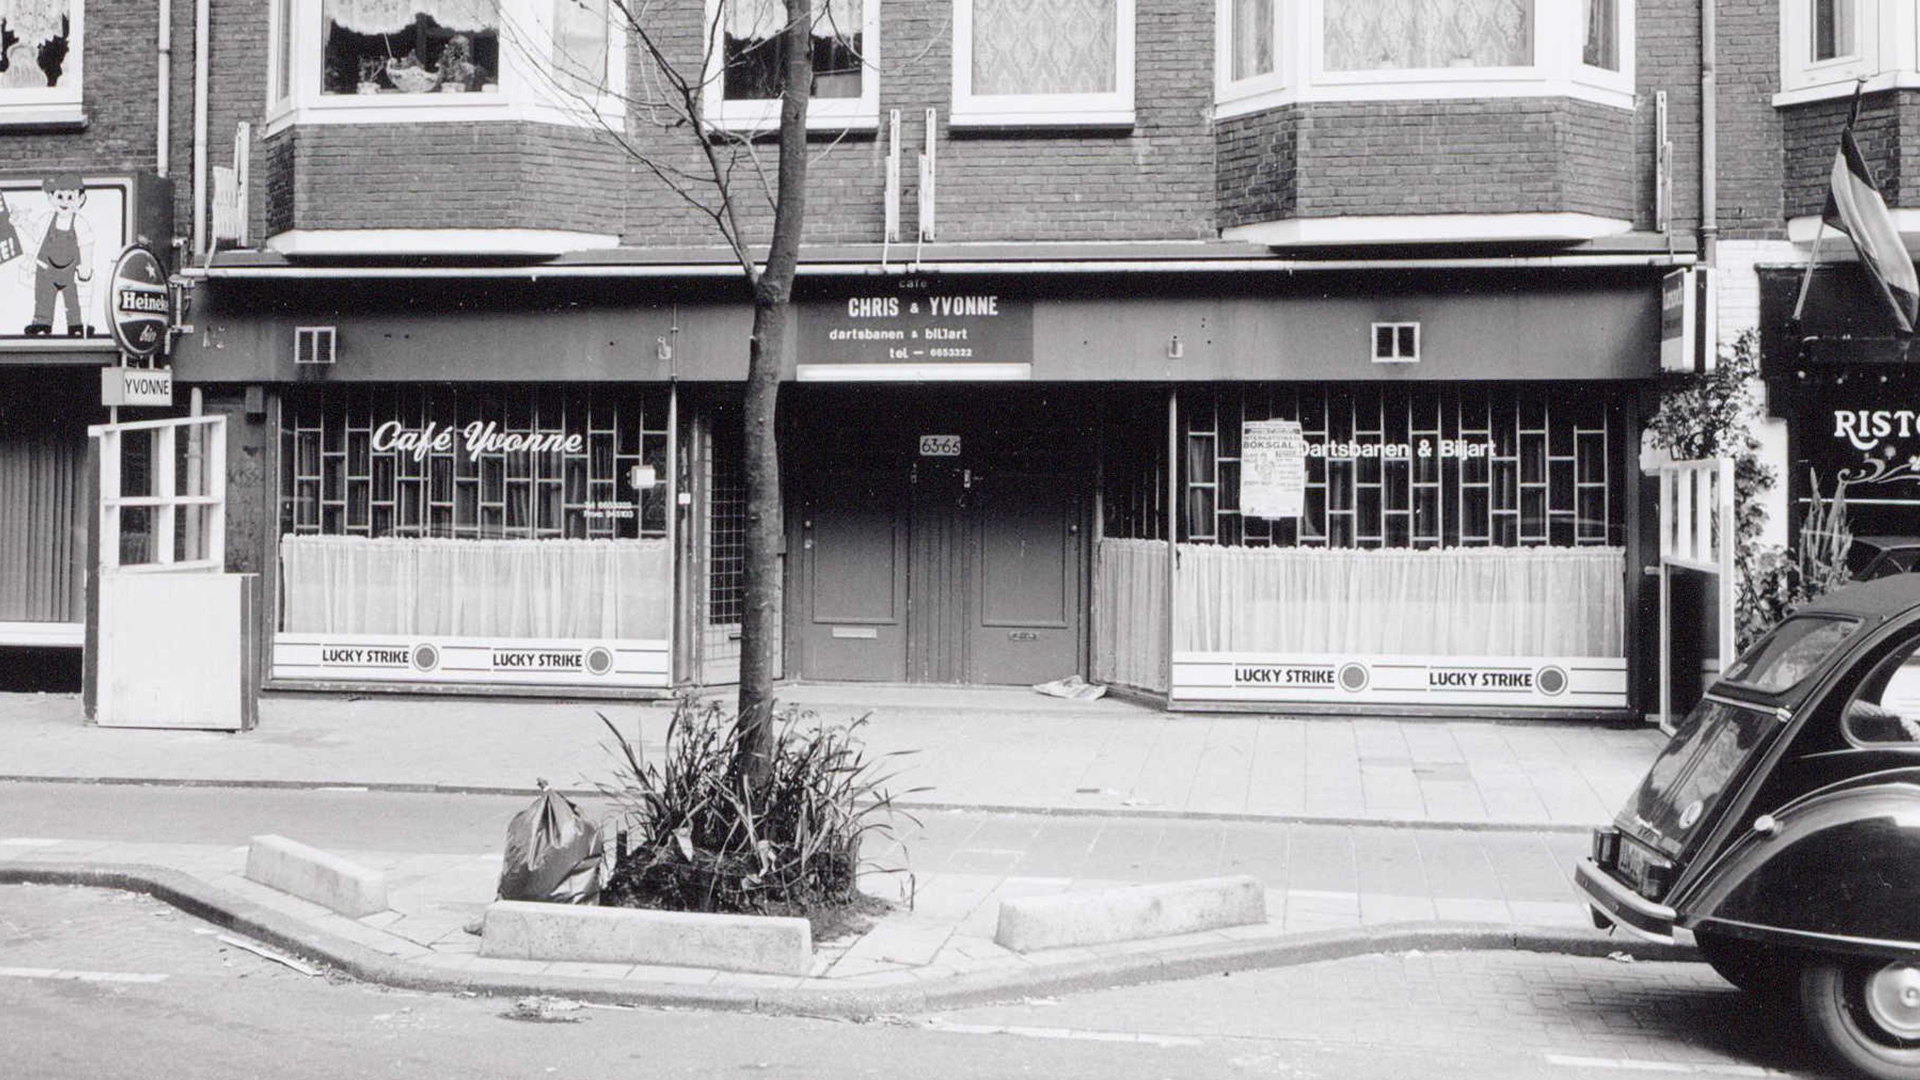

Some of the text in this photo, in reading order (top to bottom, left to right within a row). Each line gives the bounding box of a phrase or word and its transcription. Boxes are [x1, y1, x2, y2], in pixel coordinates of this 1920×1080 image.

[0, 237, 15, 260] E!
[848, 296, 999, 317] CHRIS & YVONNE
[829, 328, 904, 340] dartsbanen
[125, 378, 169, 396] YVONNE
[1834, 410, 1920, 450] RIST
[372, 421, 583, 462] Café Yvonne
[1243, 441, 1301, 449] BOKSGAL
[1417, 440, 1433, 458] &
[1440, 440, 1497, 461] Biljart
[322, 649, 409, 664] LUCKY STRIKE
[493, 653, 582, 668] LUCKY STRIKE
[1234, 668, 1335, 684] LUCKY STRIKE
[1429, 672, 1532, 688] LUCKY STRIKE
